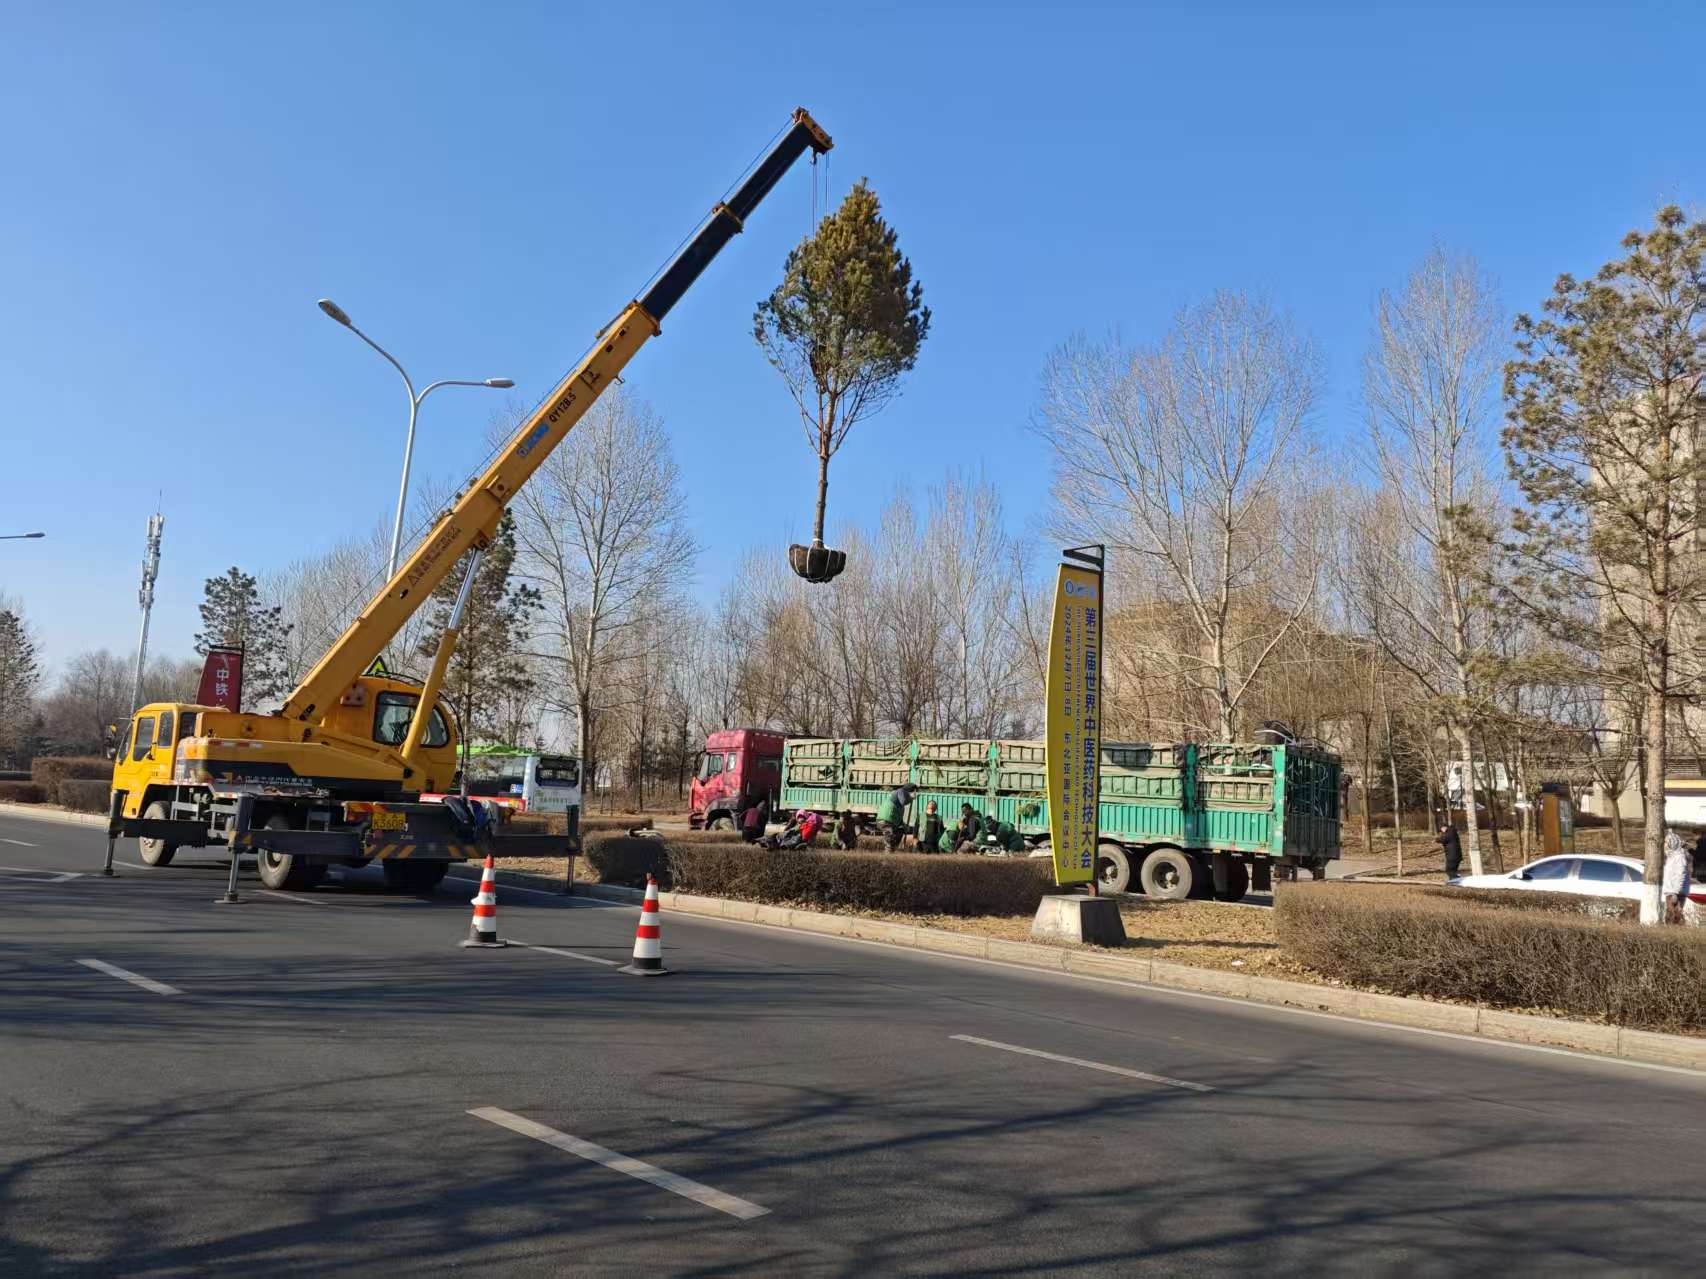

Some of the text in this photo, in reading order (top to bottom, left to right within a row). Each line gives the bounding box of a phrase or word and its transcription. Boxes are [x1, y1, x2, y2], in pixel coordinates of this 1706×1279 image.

[1081, 607, 1096, 868] 第三届世界中医药科技大会
